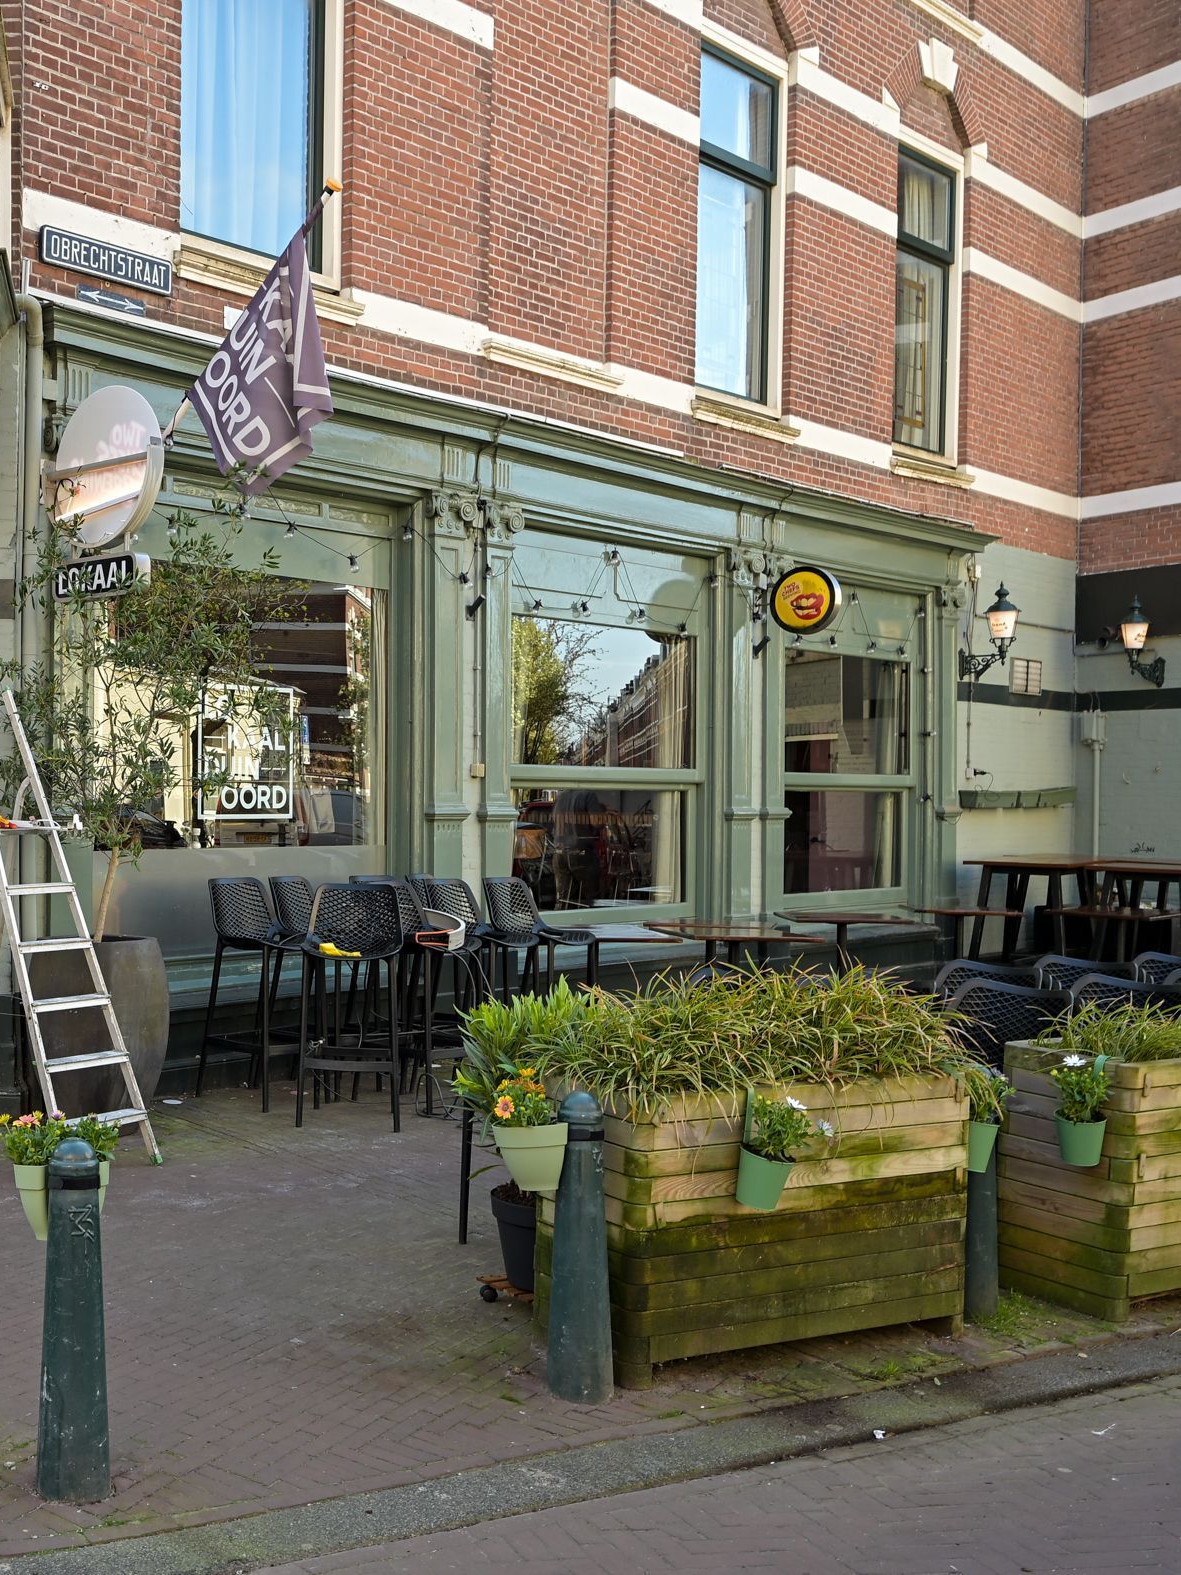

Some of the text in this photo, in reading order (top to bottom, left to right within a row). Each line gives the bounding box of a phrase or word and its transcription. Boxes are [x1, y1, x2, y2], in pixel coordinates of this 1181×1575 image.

[51, 235, 167, 288] OBRECHTSTRAAT
[229, 309, 277, 385] UIN
[205, 351, 271, 457] OORD
[221, 785, 287, 810] OORD
